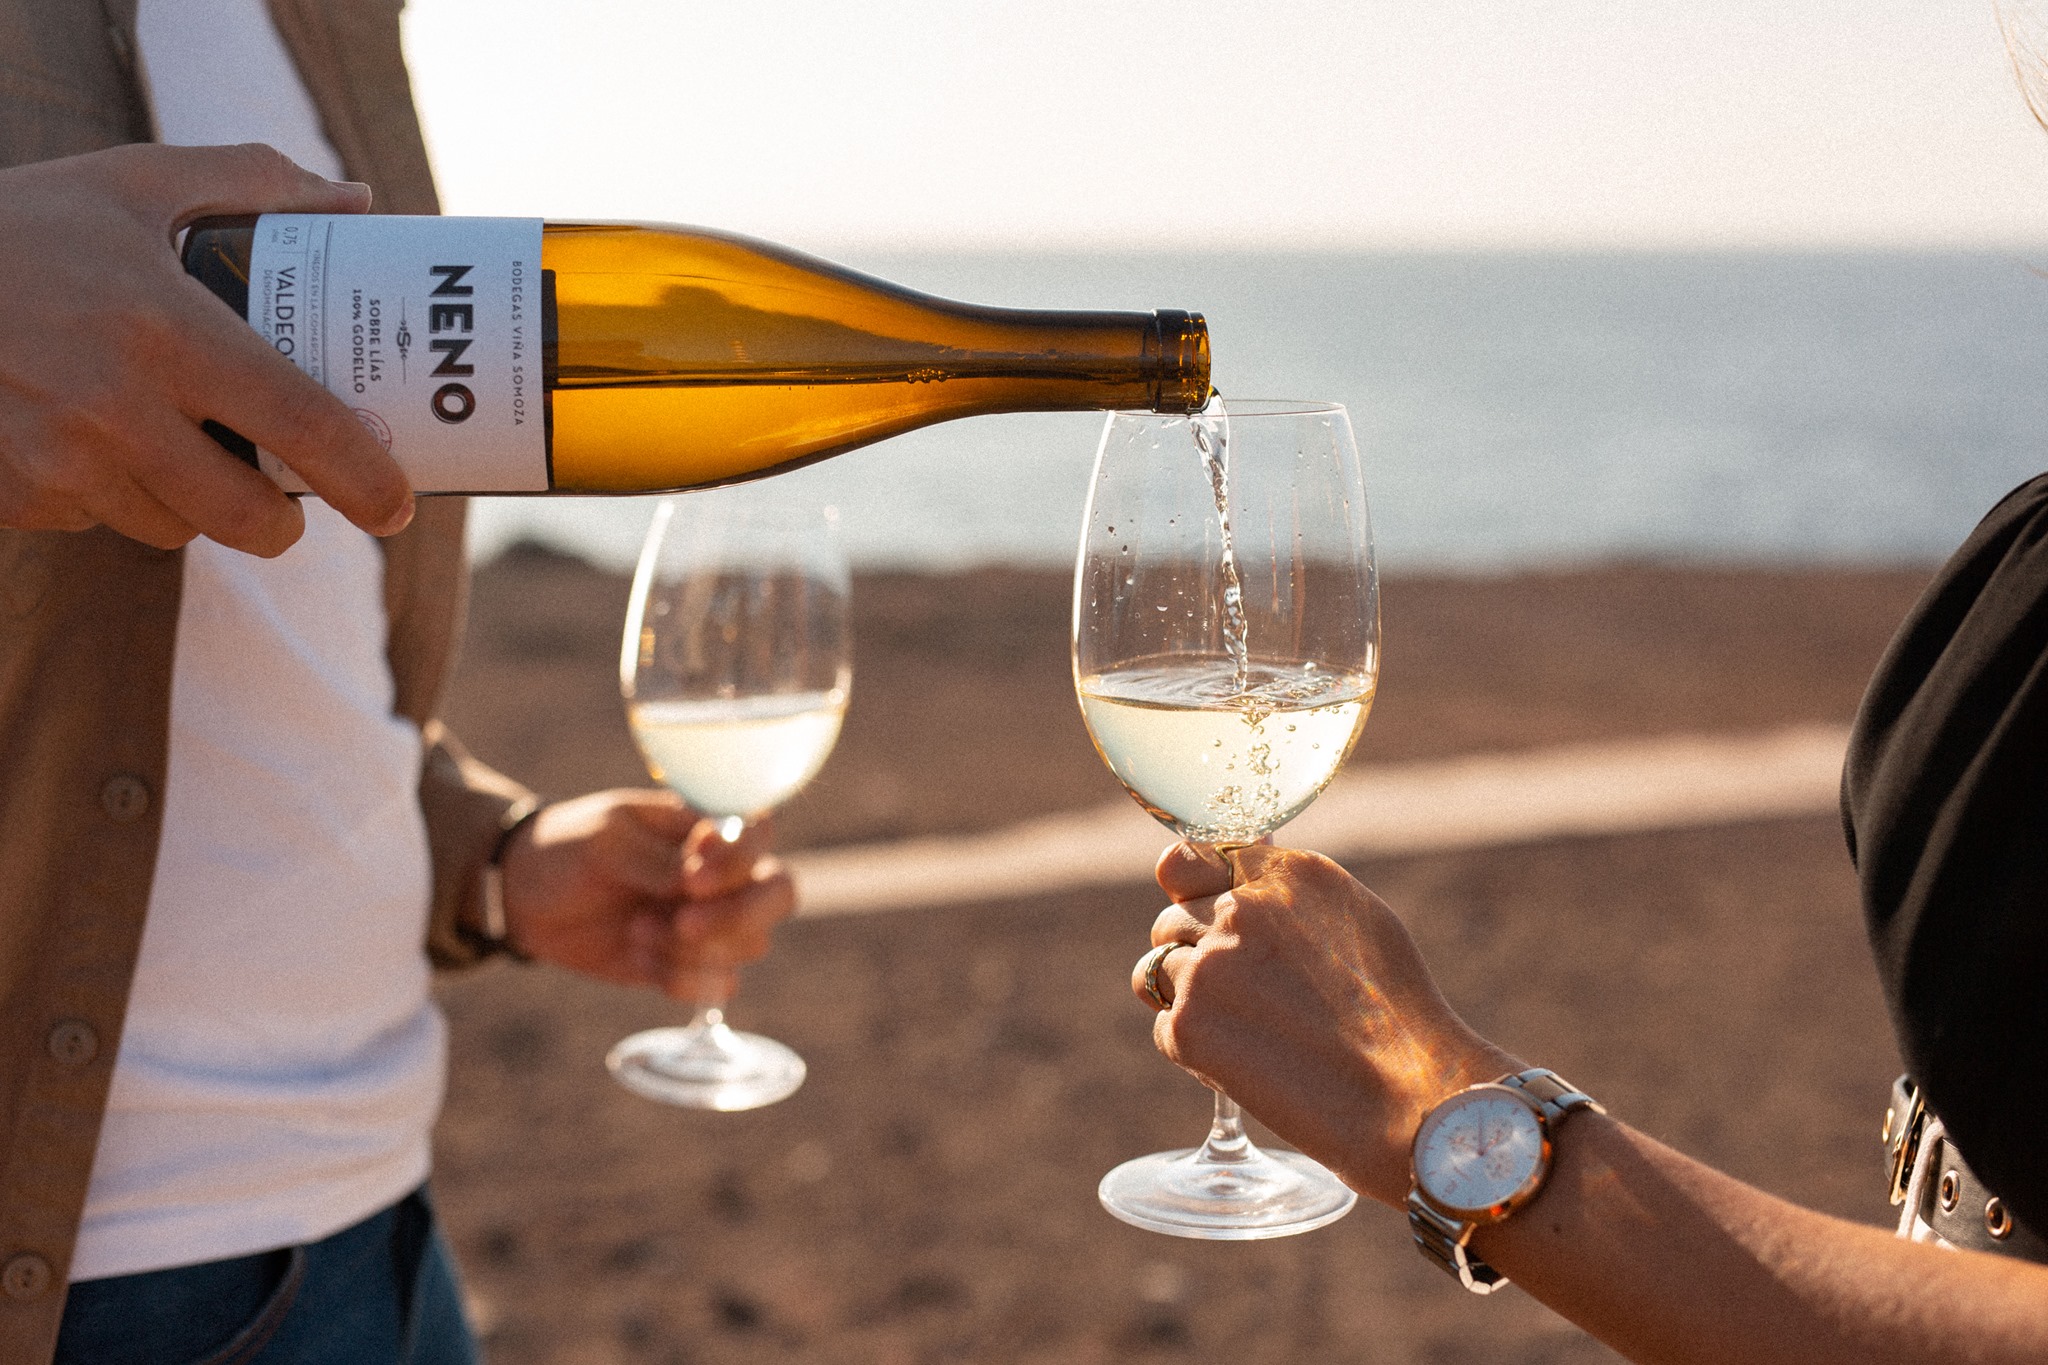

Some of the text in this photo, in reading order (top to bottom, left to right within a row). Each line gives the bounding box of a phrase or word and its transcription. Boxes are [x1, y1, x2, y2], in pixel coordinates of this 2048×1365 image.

[282, 226, 299, 245] 0,75
[275, 266, 297, 363] VALDEO
[352, 288, 366, 394] 100% GODELLO
[369, 298, 385, 382] SOBRE LÍAS
[429, 265, 476, 425] NENO
[512, 260, 525, 426] BODEGAS VIÑA SOMOZA
